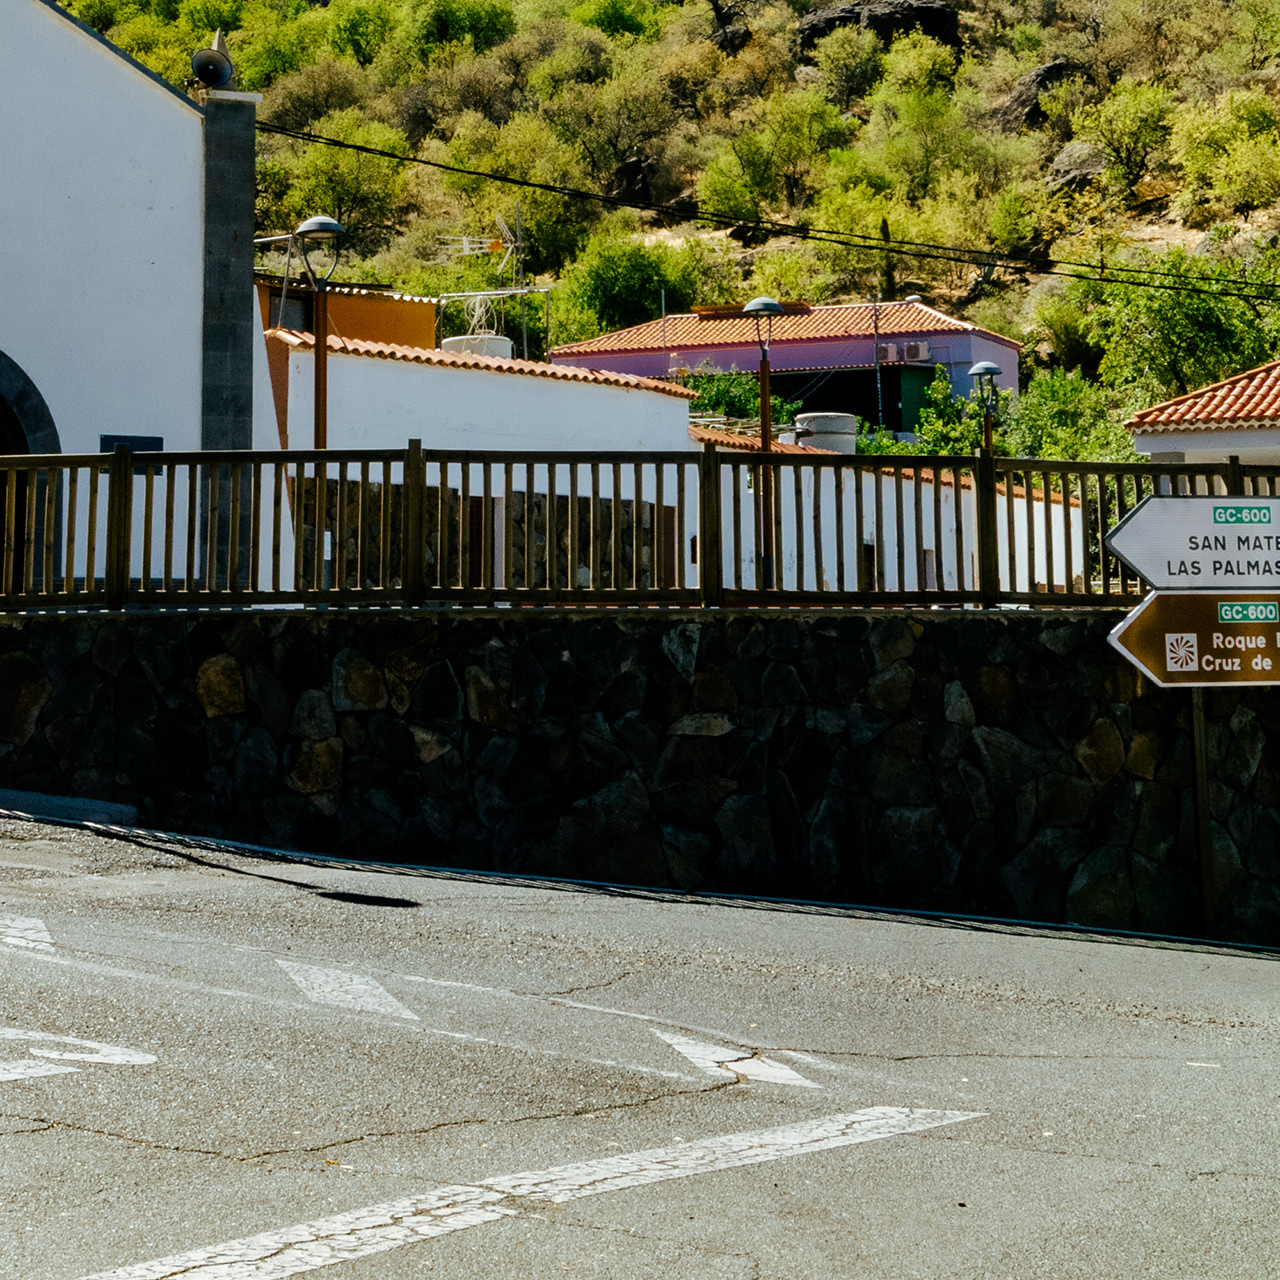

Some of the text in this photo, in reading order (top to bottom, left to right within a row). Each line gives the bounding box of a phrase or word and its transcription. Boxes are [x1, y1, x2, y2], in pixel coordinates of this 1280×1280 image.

[1215, 509, 1270, 522] GC-600
[1188, 536, 1226, 551] SAN
[1167, 560, 1202, 575] LAS
[1221, 606, 1276, 619] GC-600
[1213, 632, 1267, 651] Roque
[1201, 654, 1241, 671] Cruz
[1251, 654, 1272, 670] de
